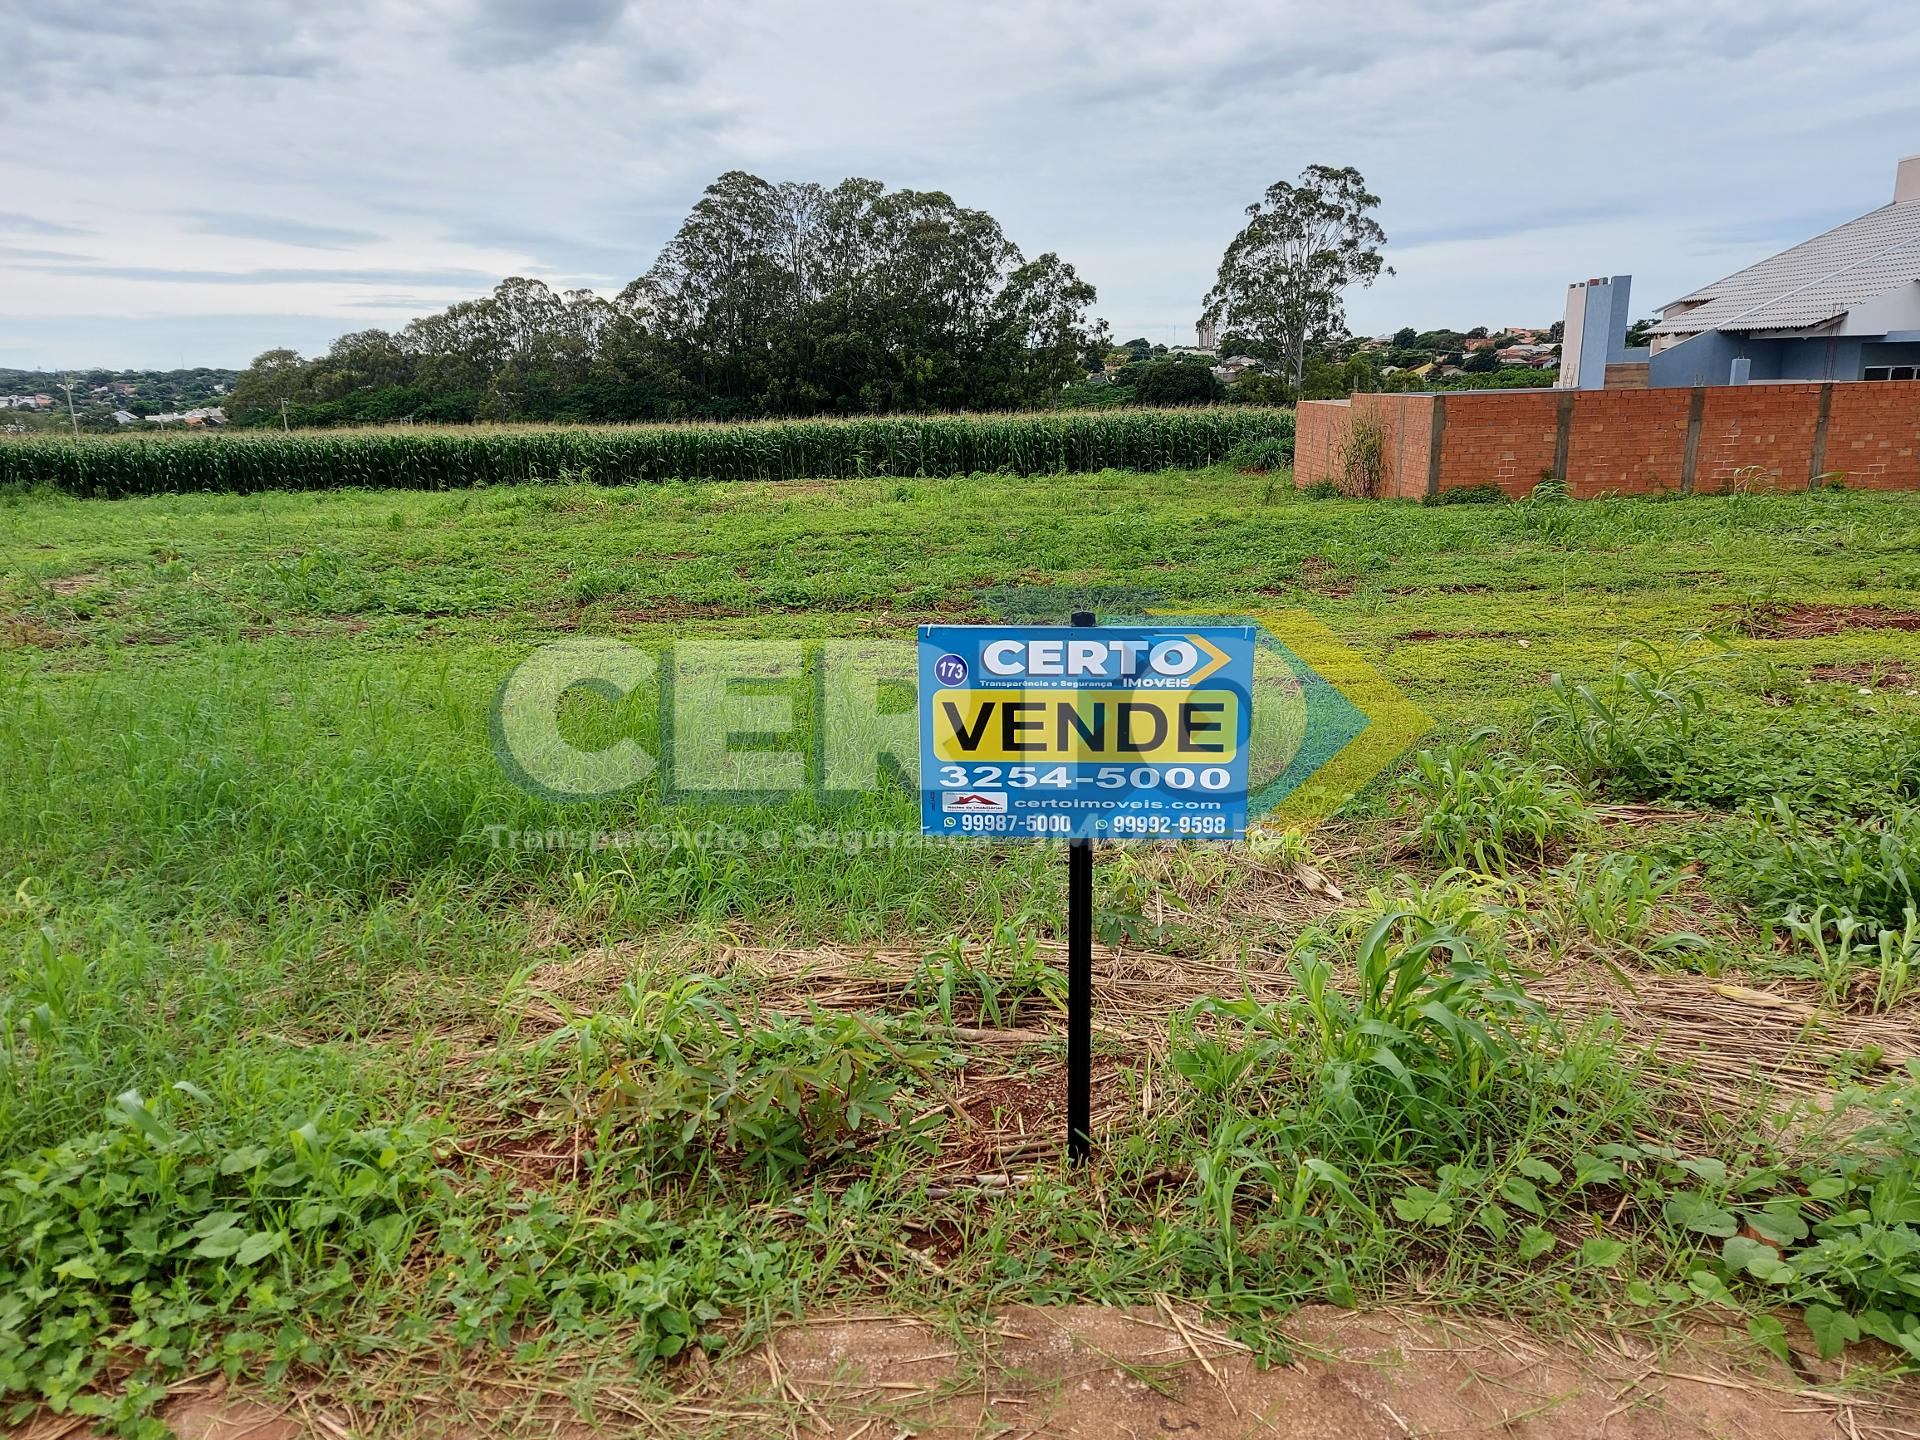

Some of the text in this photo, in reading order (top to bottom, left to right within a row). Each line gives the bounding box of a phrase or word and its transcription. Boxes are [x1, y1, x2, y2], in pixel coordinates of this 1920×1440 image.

[982, 639, 1199, 676] CERTO
[939, 661, 965, 680] 173
[1060, 680, 1113, 689] Segurança
[941, 701, 1226, 754] VENDE
[938, 766, 1232, 791] 3254-5000
[1013, 798, 1222, 810] certoimoveis.com
[961, 814, 1071, 832] 99987-5000
[1112, 815, 1226, 834] 99992-9598
